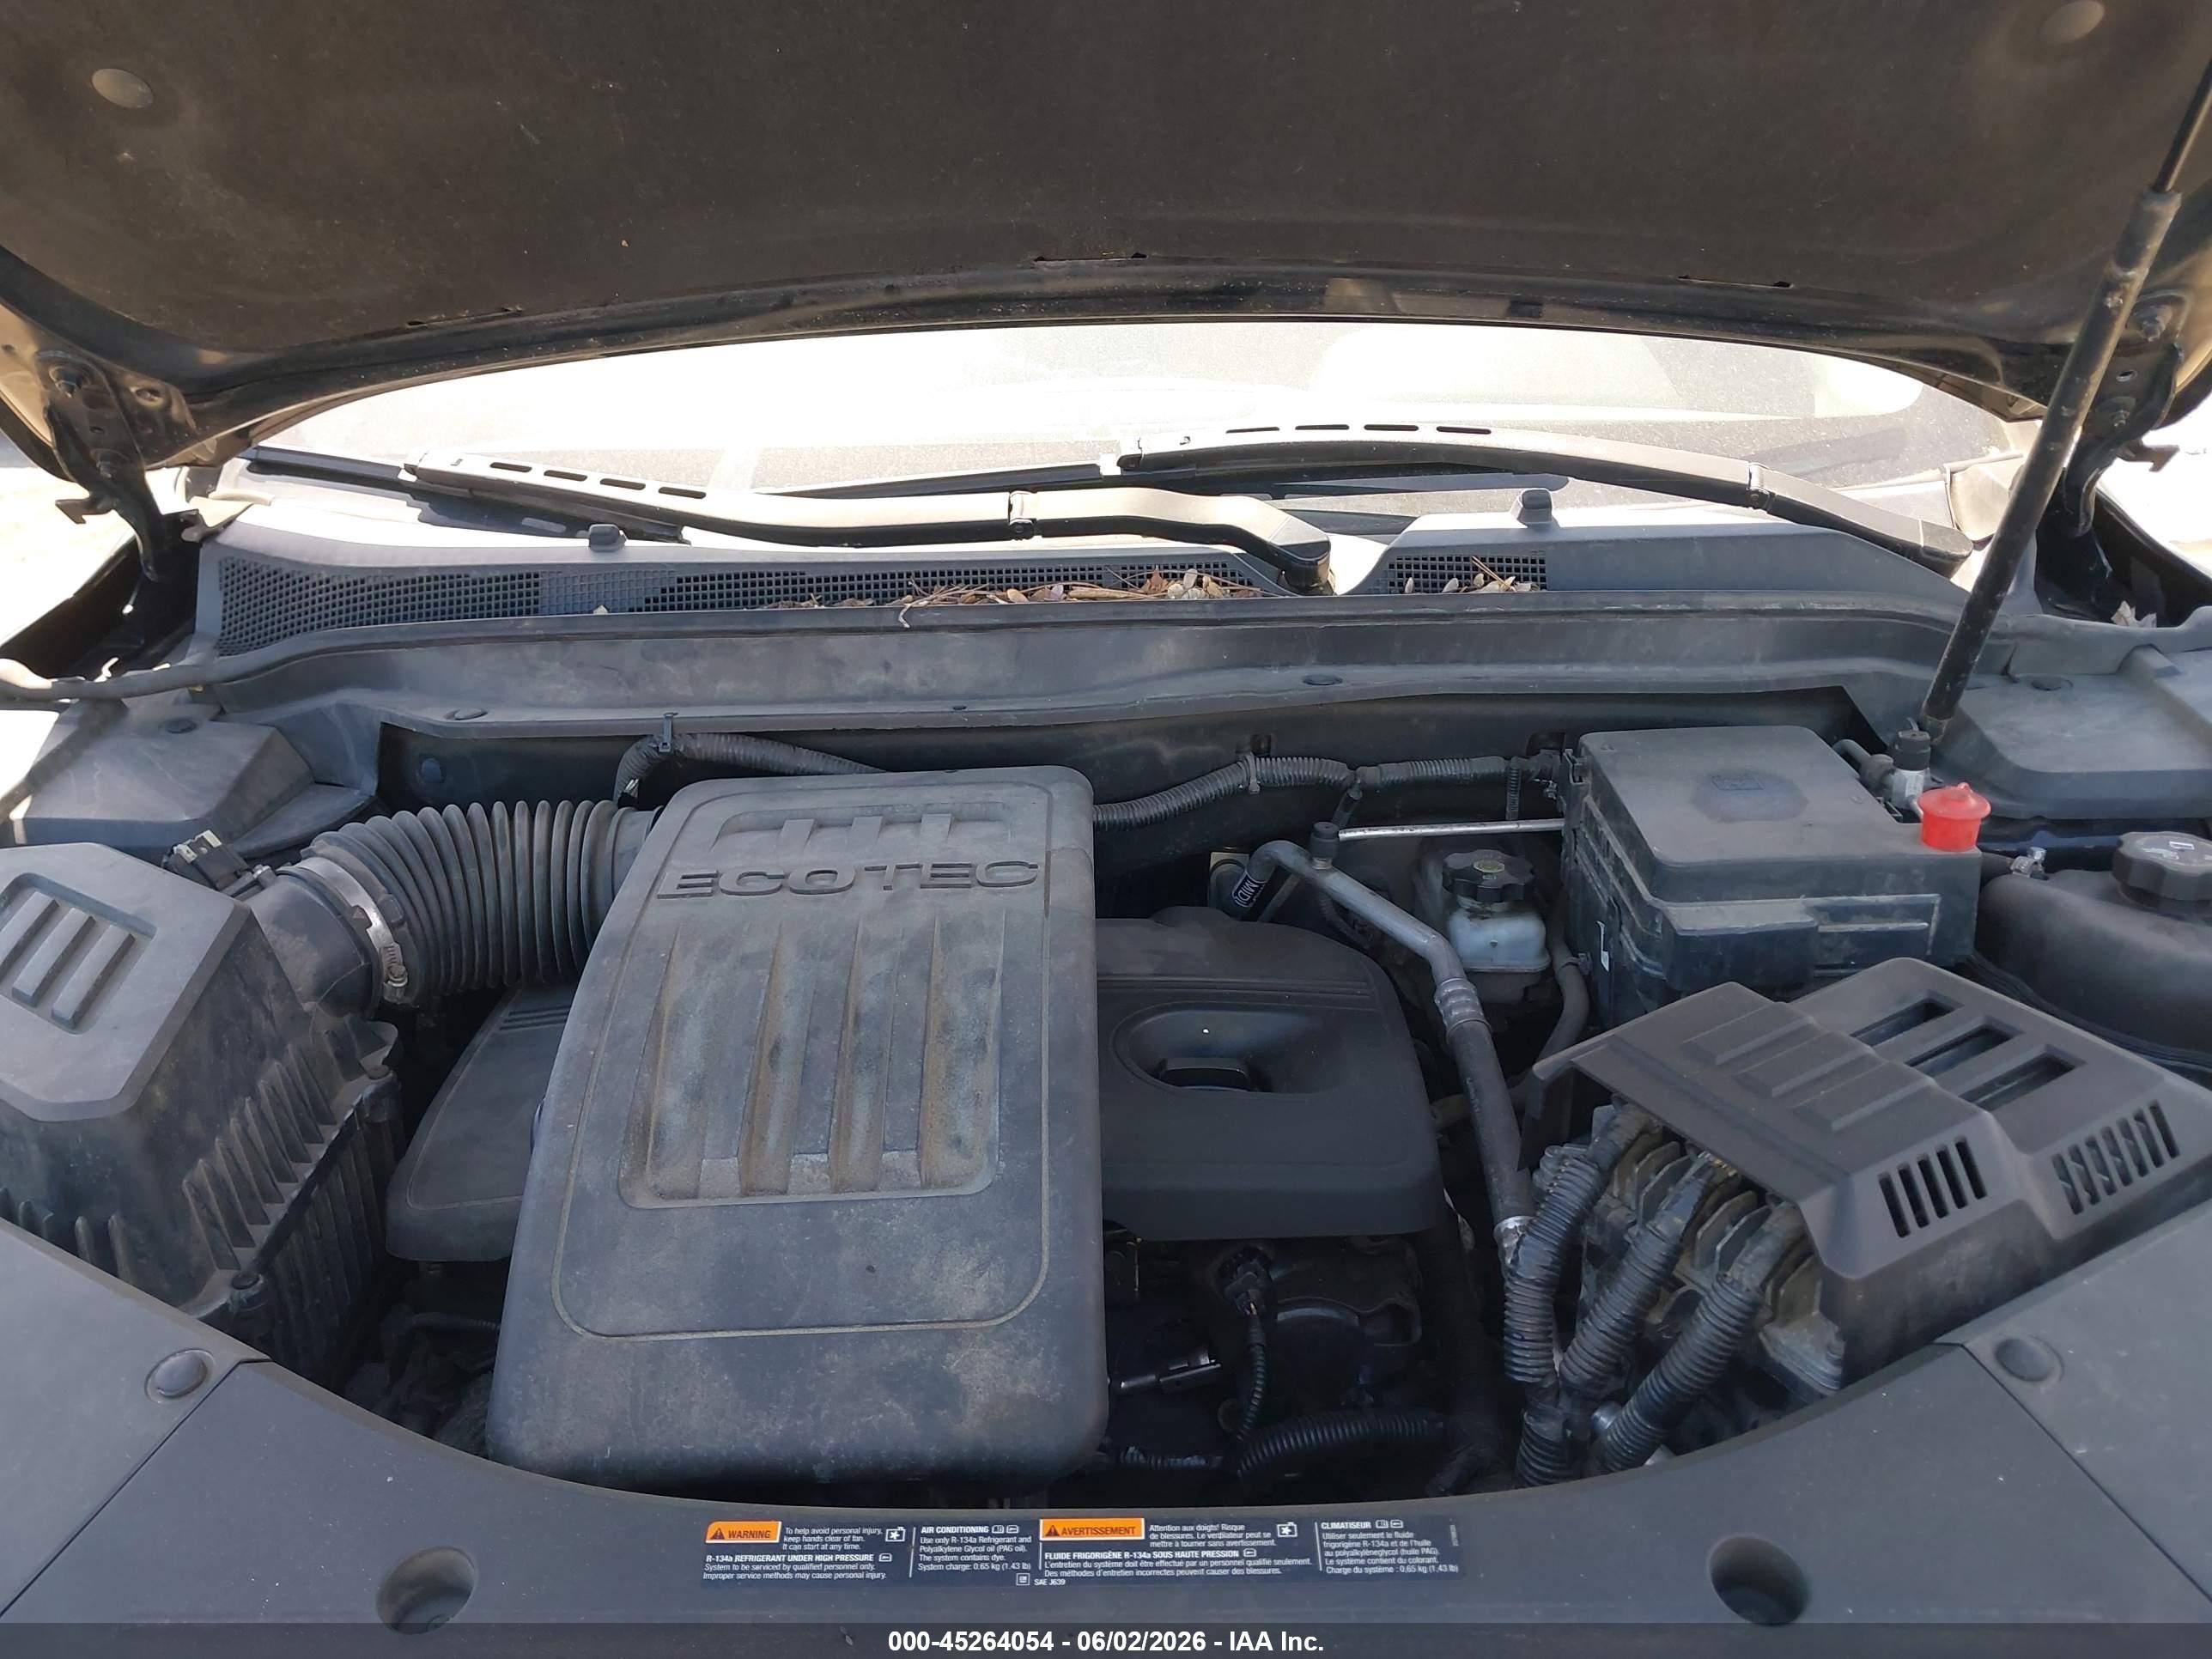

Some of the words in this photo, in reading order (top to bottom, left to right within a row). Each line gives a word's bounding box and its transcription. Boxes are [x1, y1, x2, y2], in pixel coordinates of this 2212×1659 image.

[657, 860, 1038, 899] ECOTEC
[794, 1527, 810, 1535] help
[831, 1527, 860, 1535] personal
[862, 1527, 883, 1535] injury.
[1061, 1527, 1136, 1535] AVERTISSEMENT
[1221, 1523, 1245, 1532] Risque
[728, 1530, 771, 1539] WARNING
[1245, 1531, 1261, 1540] peut
[783, 1535, 800, 1544] keep
[935, 1536, 950, 1546] only
[978, 1535, 1017, 1545] Refrigerant
[830, 1543, 842, 1552] any
[919, 1545, 962, 1553] Polyalkylene
[963, 1545, 985, 1553] Glycol
[996, 1545, 1013, 1553] (PAG
[933, 1554, 958, 1563] system
[1073, 1550, 1123, 1559] FRIGORIGÈNE
[1124, 1551, 1152, 1559] R-134a
[704, 1563, 731, 1572] System
[782, 1563, 791, 1572] by
[792, 1562, 823, 1571] qualified
[824, 1562, 859, 1571] personnel
[860, 1562, 876, 1571] only.
[918, 1563, 945, 1572] System
[945, 1563, 972, 1571] charge:
[991, 1563, 1000, 1571] kg
[1001, 1562, 1020, 1571] (1.43
[1022, 1562, 1031, 1571] lb)
[1093, 1560, 1123, 1570] système
[1210, 1559, 1244, 1568] personnel
[1176, 1568, 1205, 1577] peuvent
[1326, 1566, 1352, 1576] Charge
[1418, 1565, 1428, 1573] kg
[1449, 1565, 1459, 1573] lb)
[702, 1571, 734, 1581] Improper
[834, 1571, 864, 1580] personal
[866, 1571, 887, 1580] injury.
